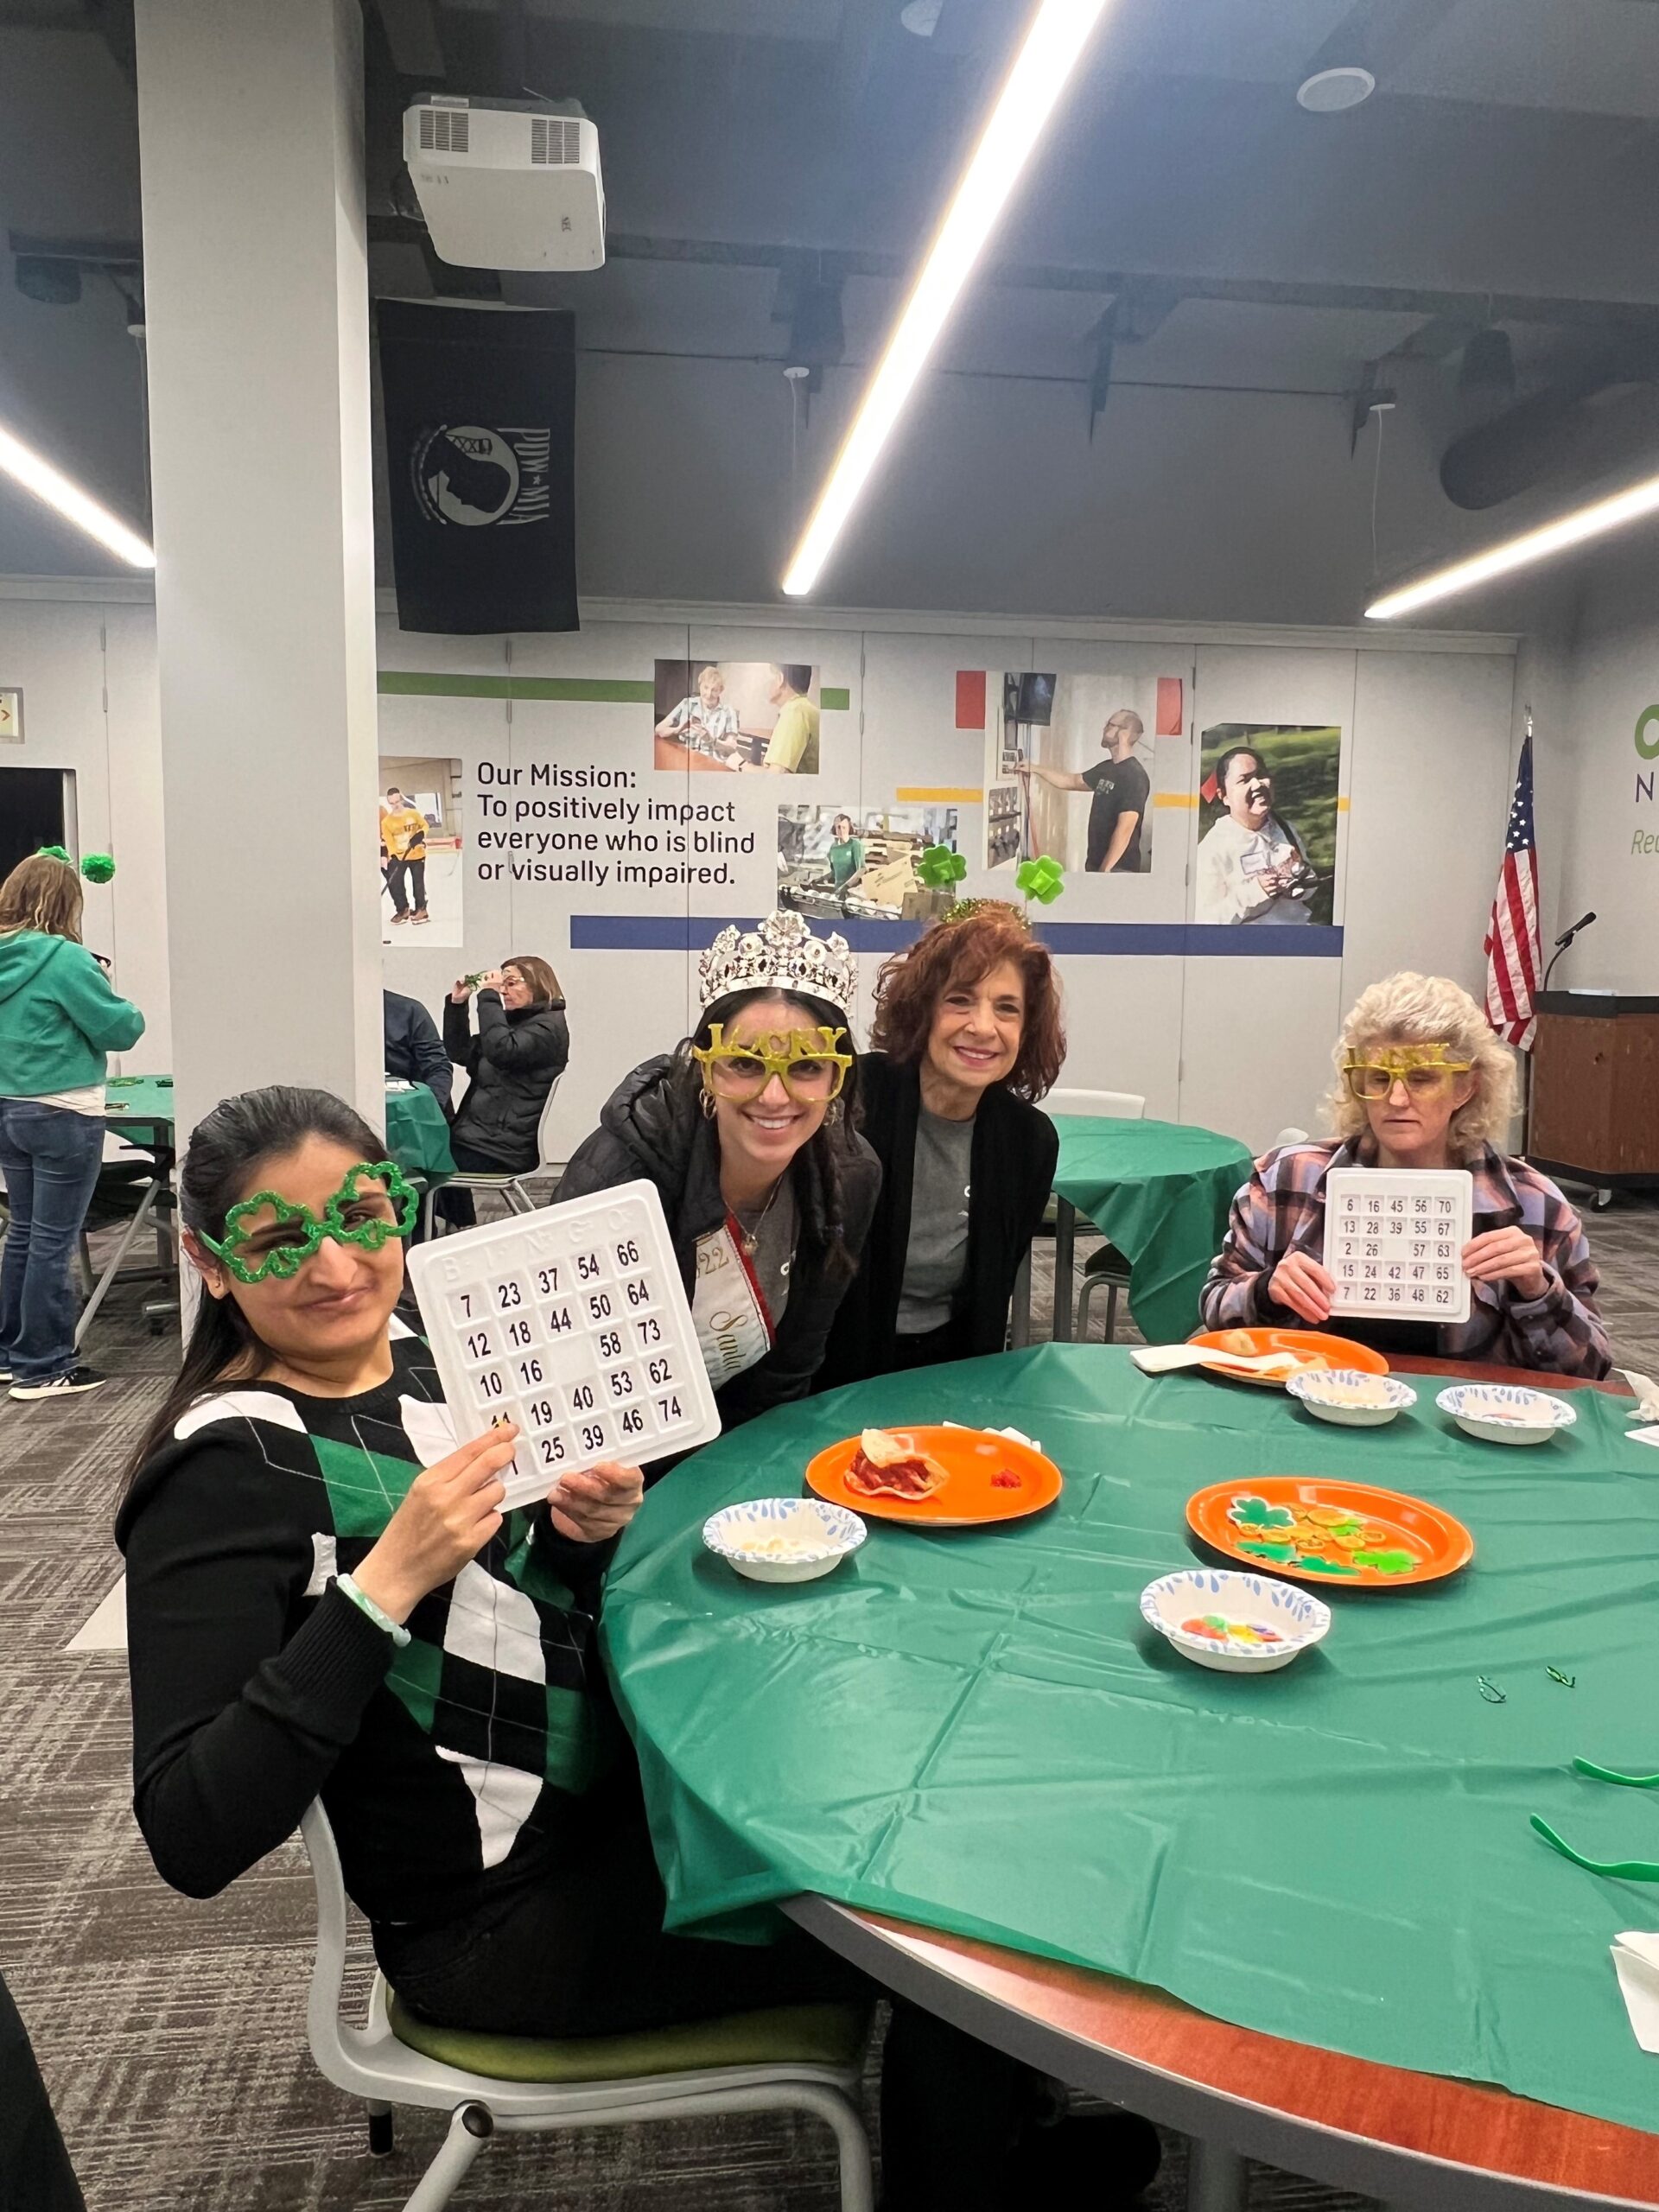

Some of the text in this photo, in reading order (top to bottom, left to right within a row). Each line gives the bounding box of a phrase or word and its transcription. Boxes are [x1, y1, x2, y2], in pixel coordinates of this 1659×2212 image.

[496, 428, 550, 525] POW MIA
[477, 762, 637, 789] Our Mission:
[477, 794, 735, 824] To positively impact
[477, 829, 755, 854] everyone who is blind
[477, 860, 735, 887] or visually impaired.
[1346, 1198, 1353, 1211] 6
[1368, 1200, 1380, 1212] 16
[1390, 1200, 1403, 1212] 45
[1439, 1201, 1451, 1213] 70
[1344, 1221, 1355, 1233] 13
[1366, 1222, 1379, 1234] 28
[1414, 1221, 1427, 1234] 55
[1438, 1223, 1450, 1236] 67
[696, 1246, 729, 1279] 22
[1345, 1243, 1351, 1255] 2
[1366, 1244, 1378, 1256] 26
[1414, 1244, 1425, 1256] 57
[461, 1241, 639, 1317] 7 23 37 54 66
[1343, 1265, 1354, 1277] 15
[1364, 1266, 1376, 1278] 24
[1389, 1267, 1401, 1279] 42
[1413, 1267, 1424, 1279] 47
[1344, 1287, 1449, 1303] 7 22 36 48 62
[468, 1280, 649, 1357] 12 18 44 50 64
[480, 1319, 660, 1396] 10 16 58 73
[531, 1402, 552, 1425] 19
[574, 1386, 593, 1409] 40
[611, 1371, 632, 1395] 53
[650, 1359, 671, 1383] 62
[542, 1437, 563, 1463] 25
[583, 1425, 603, 1450] 39
[623, 1409, 643, 1433] 46
[658, 1396, 681, 1421] 74
